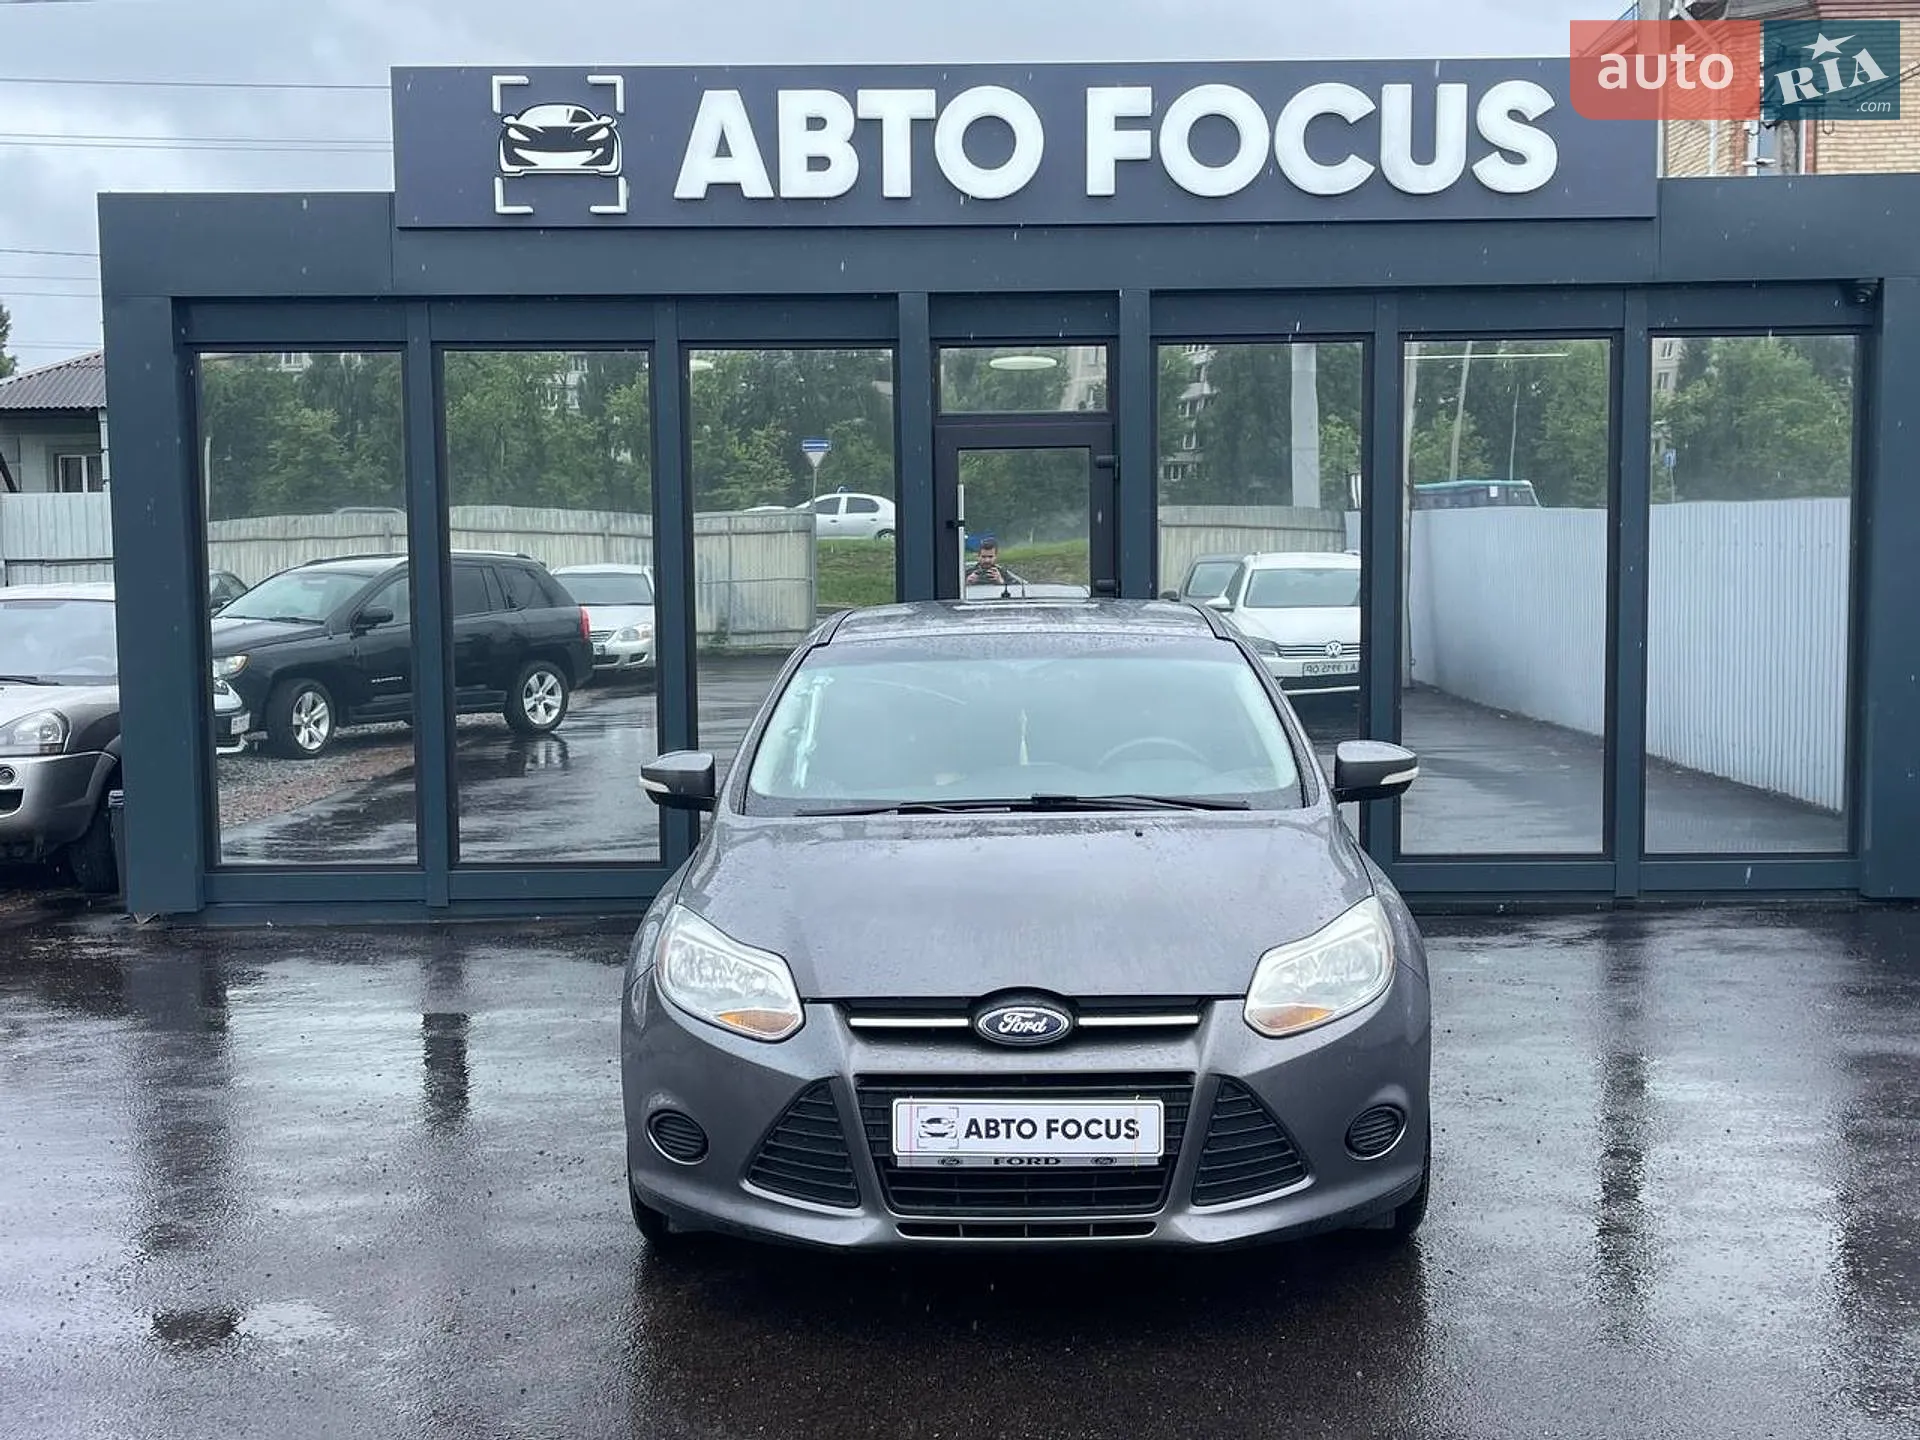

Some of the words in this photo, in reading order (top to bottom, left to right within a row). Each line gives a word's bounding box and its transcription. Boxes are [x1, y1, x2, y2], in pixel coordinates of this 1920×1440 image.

[673, 85, 1044, 200] АВТО
[1086, 82, 1558, 197] FOCUS
[998, 1013, 1047, 1033] Ford
[964, 1117, 1037, 1139] АВТО
[1046, 1117, 1140, 1139] FOCUS
[993, 1157, 1061, 1165] FORD
